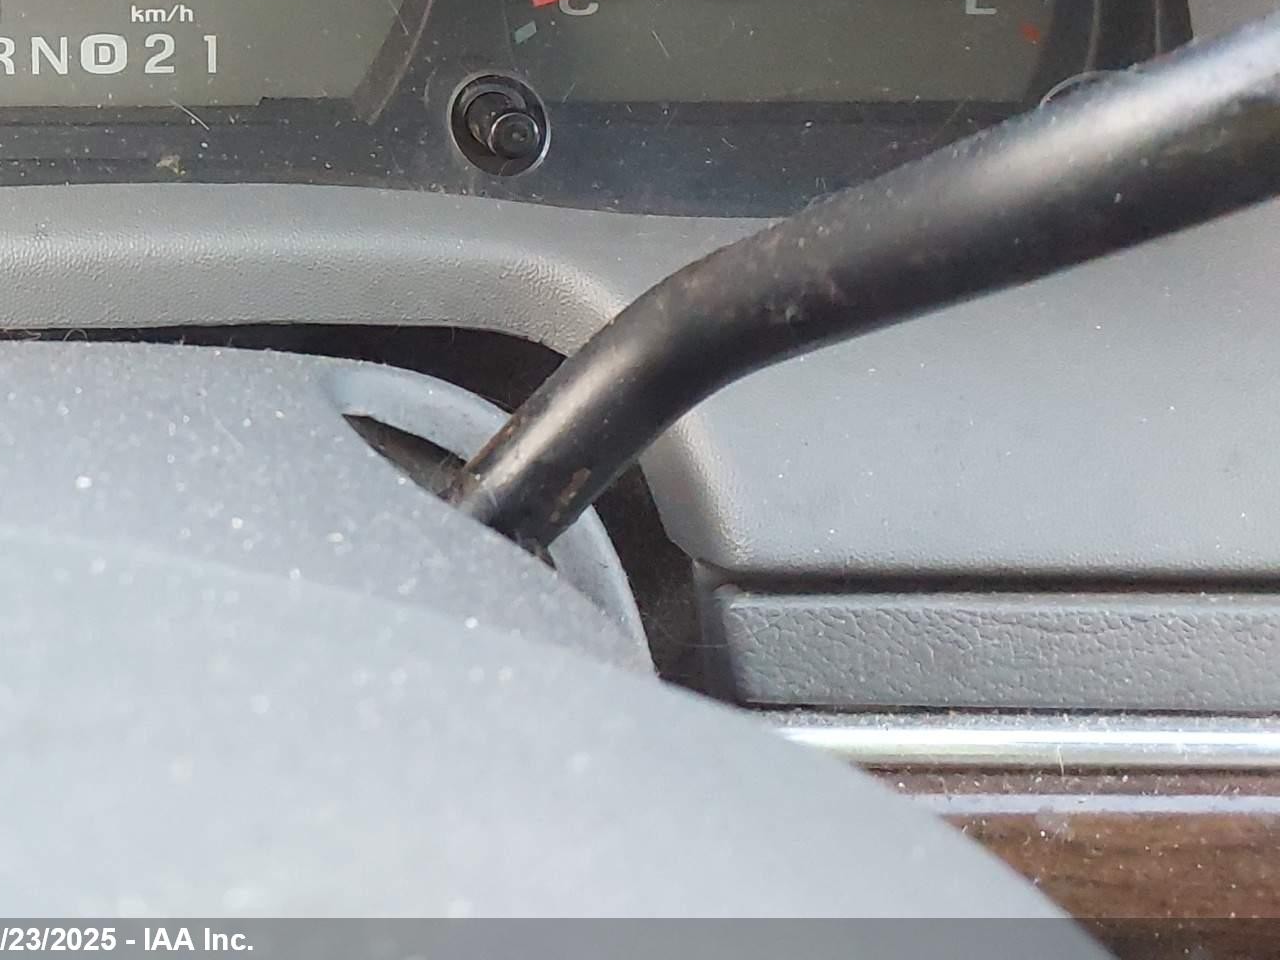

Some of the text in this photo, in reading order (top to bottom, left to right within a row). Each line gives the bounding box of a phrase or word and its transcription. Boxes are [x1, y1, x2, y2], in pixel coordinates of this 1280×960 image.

[130, 4, 194, 22] km/h
[32, 38, 68, 74] N
[145, 34, 175, 74] 2
[203, 35, 217, 74] 1
